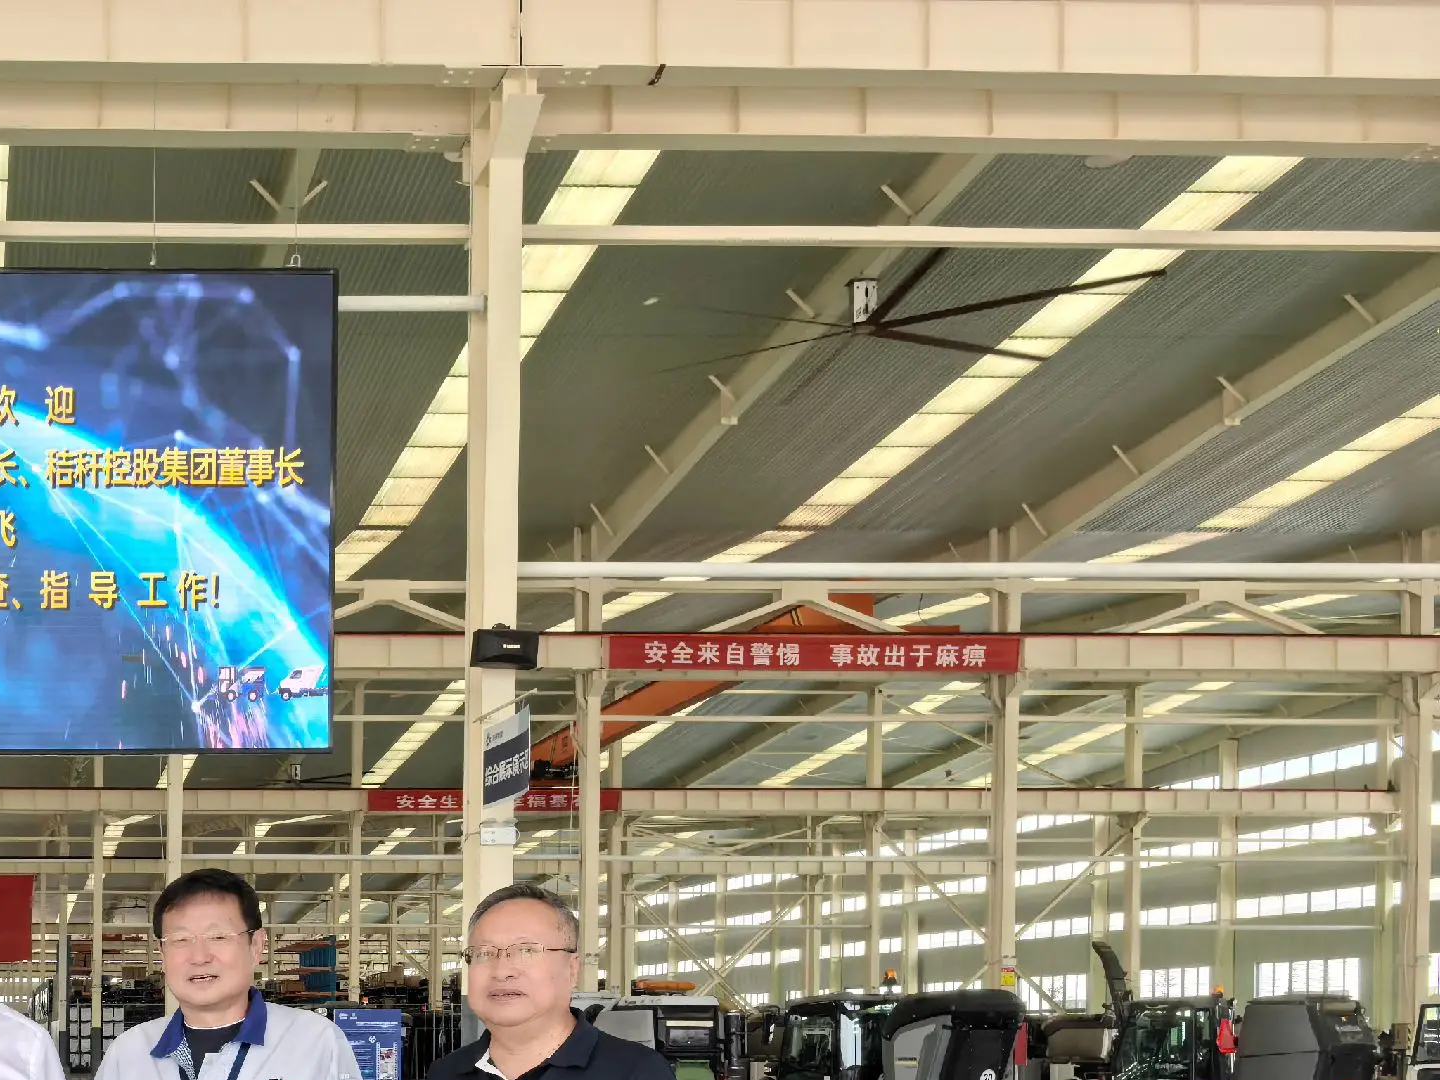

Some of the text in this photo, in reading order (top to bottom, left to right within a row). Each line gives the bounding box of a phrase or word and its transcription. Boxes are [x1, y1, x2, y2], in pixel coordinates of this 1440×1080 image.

[644, 640, 987, 668] 安全来自警惕 事故出于麻痹
